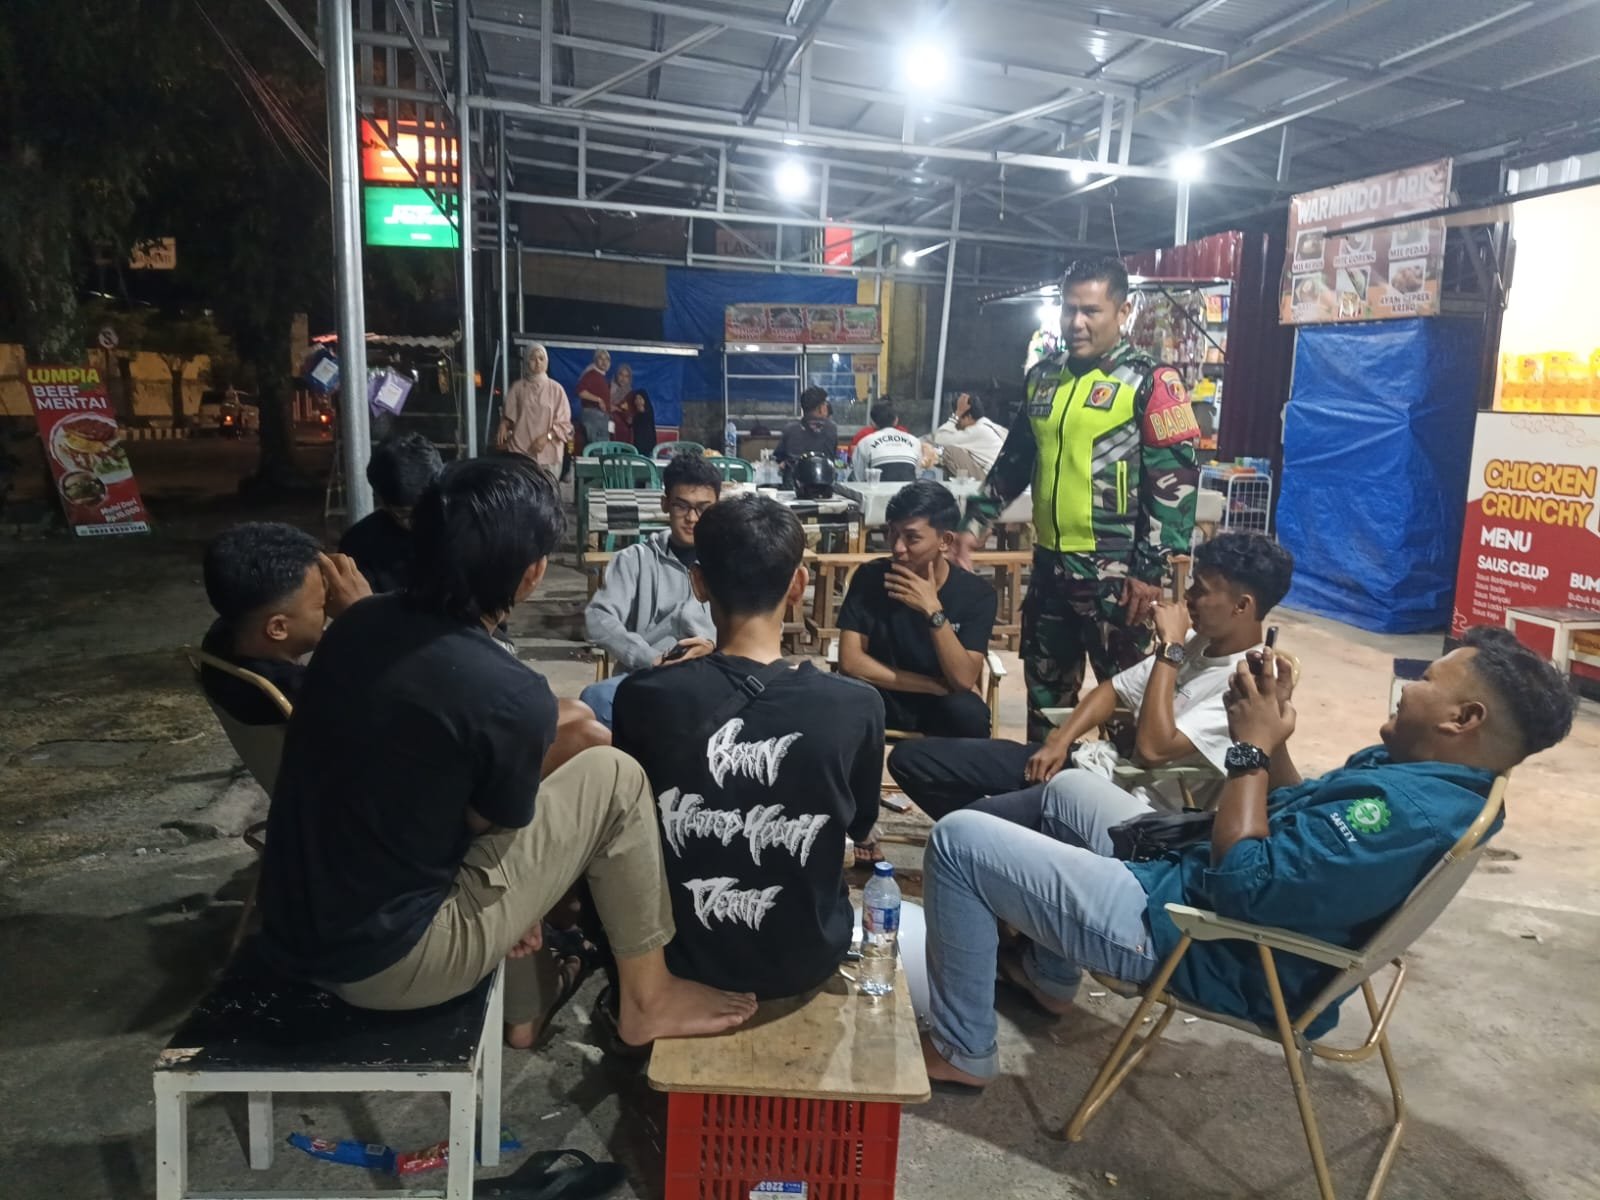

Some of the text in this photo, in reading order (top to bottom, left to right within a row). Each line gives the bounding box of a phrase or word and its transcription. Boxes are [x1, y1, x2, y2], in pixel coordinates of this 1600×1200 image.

[1298, 172, 1438, 225] WARMINDO LARIS
[27, 367, 100, 383] LUMPIA
[31, 385, 80, 397] BEEF
[36, 397, 107, 410] MENTAI
[1484, 458, 1597, 499] CHICKEN
[1481, 491, 1594, 528] CRUNCHY
[1480, 525, 1532, 553] MENU
[1477, 555, 1549, 580] SAUS CELUP
[1329, 812, 1357, 842] SAFETY
[681, 876, 784, 931] DEATH
